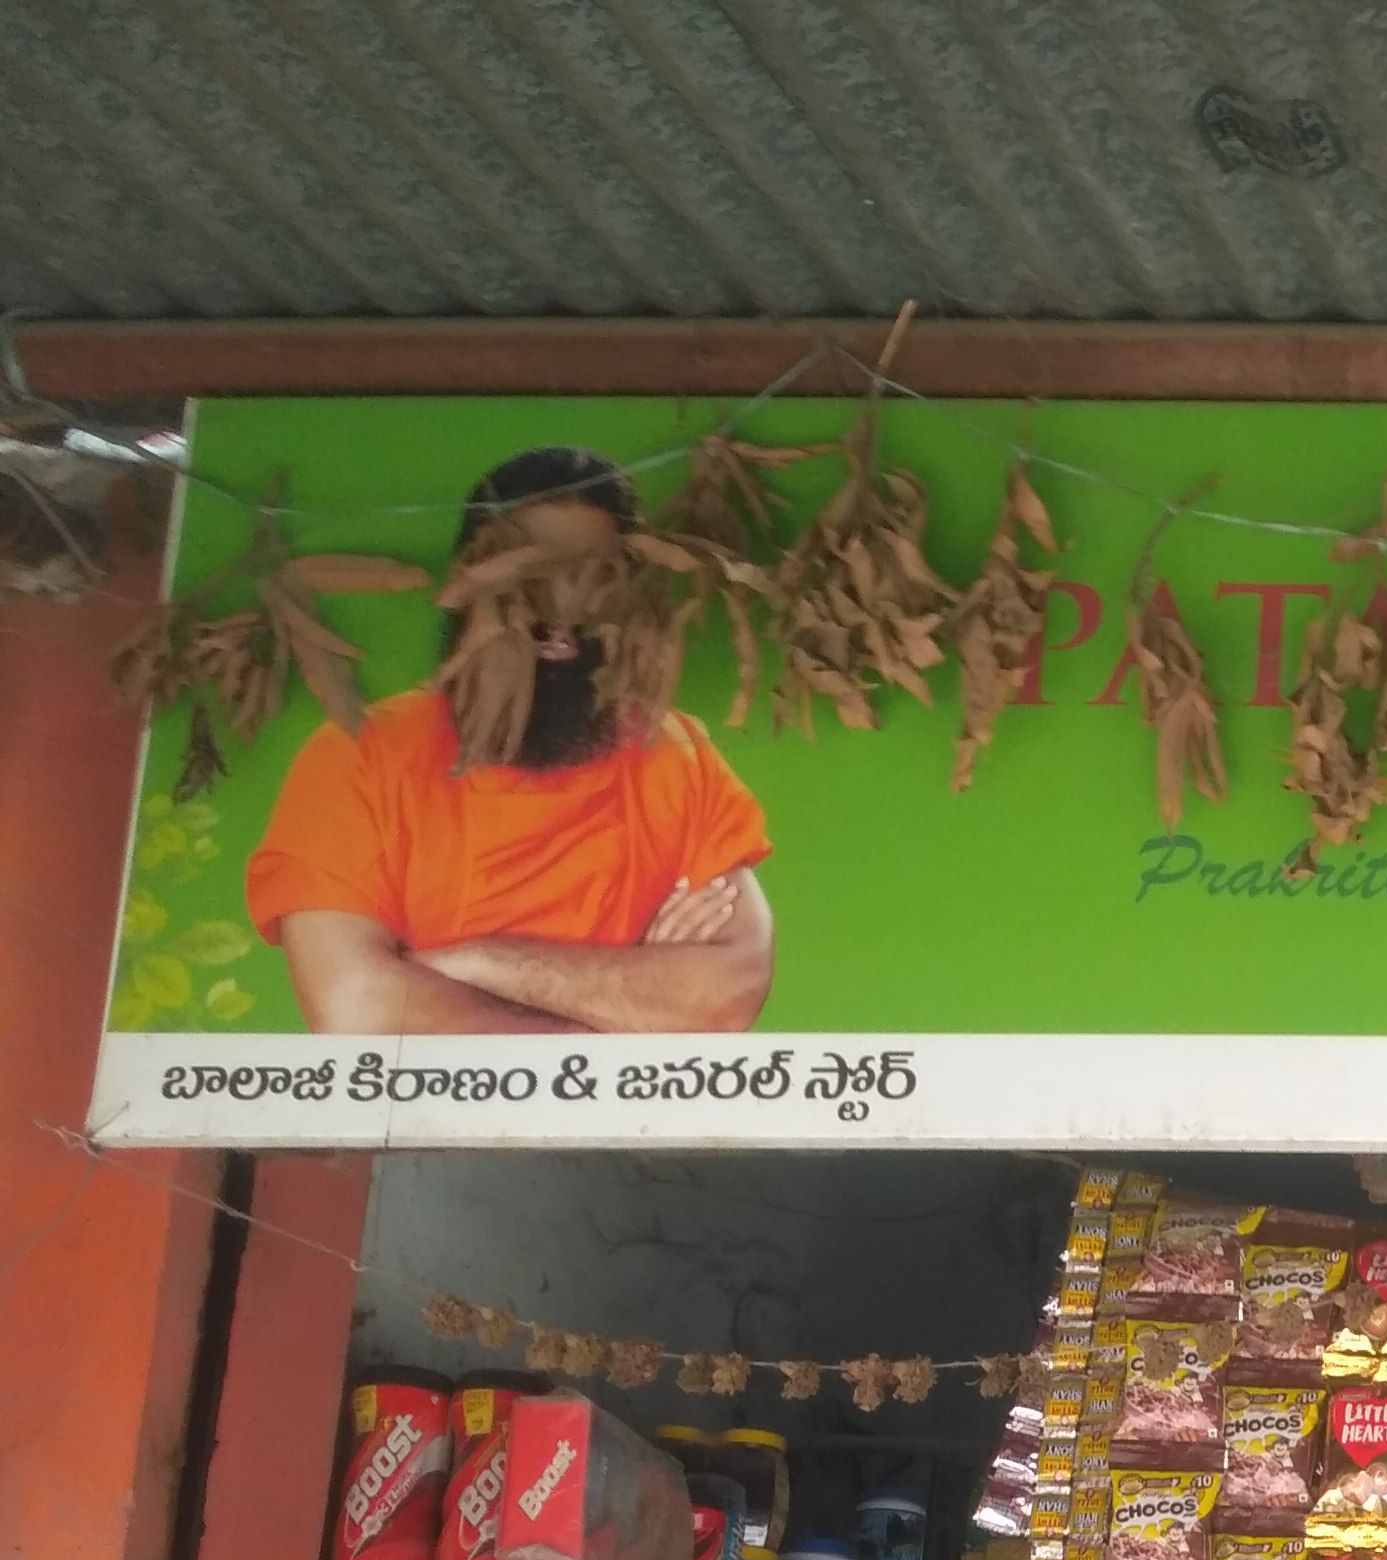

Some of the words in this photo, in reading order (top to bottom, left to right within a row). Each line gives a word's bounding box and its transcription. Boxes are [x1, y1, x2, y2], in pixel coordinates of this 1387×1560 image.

[161, 1052, 337, 1102] బాలాజీ
[346, 1052, 537, 1104] కిరాణం
[552, 1056, 598, 1100] &
[616, 1051, 793, 1102] జనరల్
[803, 1050, 918, 1122] స్టోర్
[1245, 1270, 1325, 1291] CHOCOS
[1115, 1500, 1197, 1524] CHOCOS
